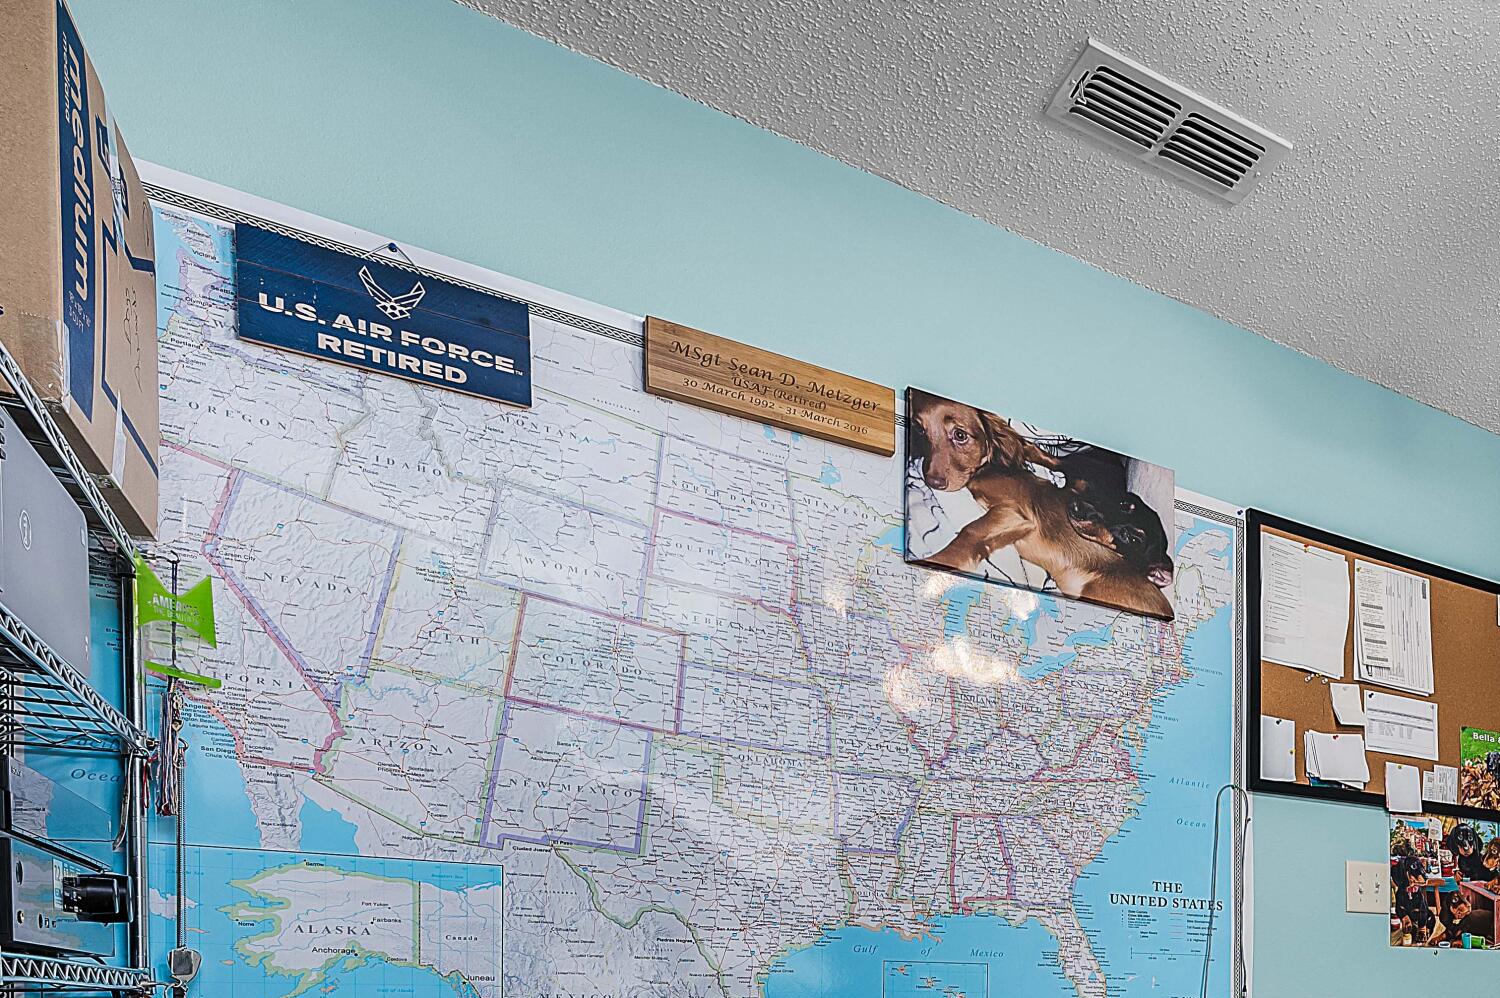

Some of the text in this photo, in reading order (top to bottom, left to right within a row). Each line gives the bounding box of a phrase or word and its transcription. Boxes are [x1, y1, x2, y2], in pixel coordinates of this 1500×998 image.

[61, 31, 72, 124] mediana
[67, 43, 92, 301] medium
[210, 285, 235, 296] Seattle
[185, 296, 213, 307] Olympia
[258, 292, 326, 324] U.S.
[331, 314, 393, 342] AIR
[400, 330, 515, 373] FORCE
[171, 338, 200, 348] Portland
[317, 333, 467, 384] RETIRED
[669, 340, 881, 412] MSgt Sean D. Metzger
[731, 376, 827, 411] USAF (Retired)
[188, 402, 288, 430] OREGON
[683, 378, 698, 388] 30
[702, 381, 745, 401] March
[749, 396, 775, 409] 1992
[800, 408, 840, 428] March
[843, 423, 868, 435] 2016
[499, 415, 591, 444] MONTANA
[375, 455, 442, 477] IDAHO
[730, 494, 788, 513] DAKOTA
[524, 556, 616, 582] WYOMING
[263, 571, 353, 595] NEVADA
[428, 630, 480, 646] UTAH
[541, 652, 642, 677] COLORADO
[357, 736, 453, 755] ARIZONA
[1472, 732, 1495, 743] Bella
[738, 753, 803, 768] OKLAHOMA
[509, 777, 632, 798] NEW MEXICO
[1169, 776, 1211, 789] Atlantic
[1176, 817, 1207, 828] Ocean
[1152, 881, 1183, 894] THE
[1109, 893, 1223, 911] UNITED STATES
[294, 924, 371, 936] ALASKA
[853, 944, 878, 955] Gulf
[921, 946, 933, 957] of
[970, 947, 1004, 959] Mexico
